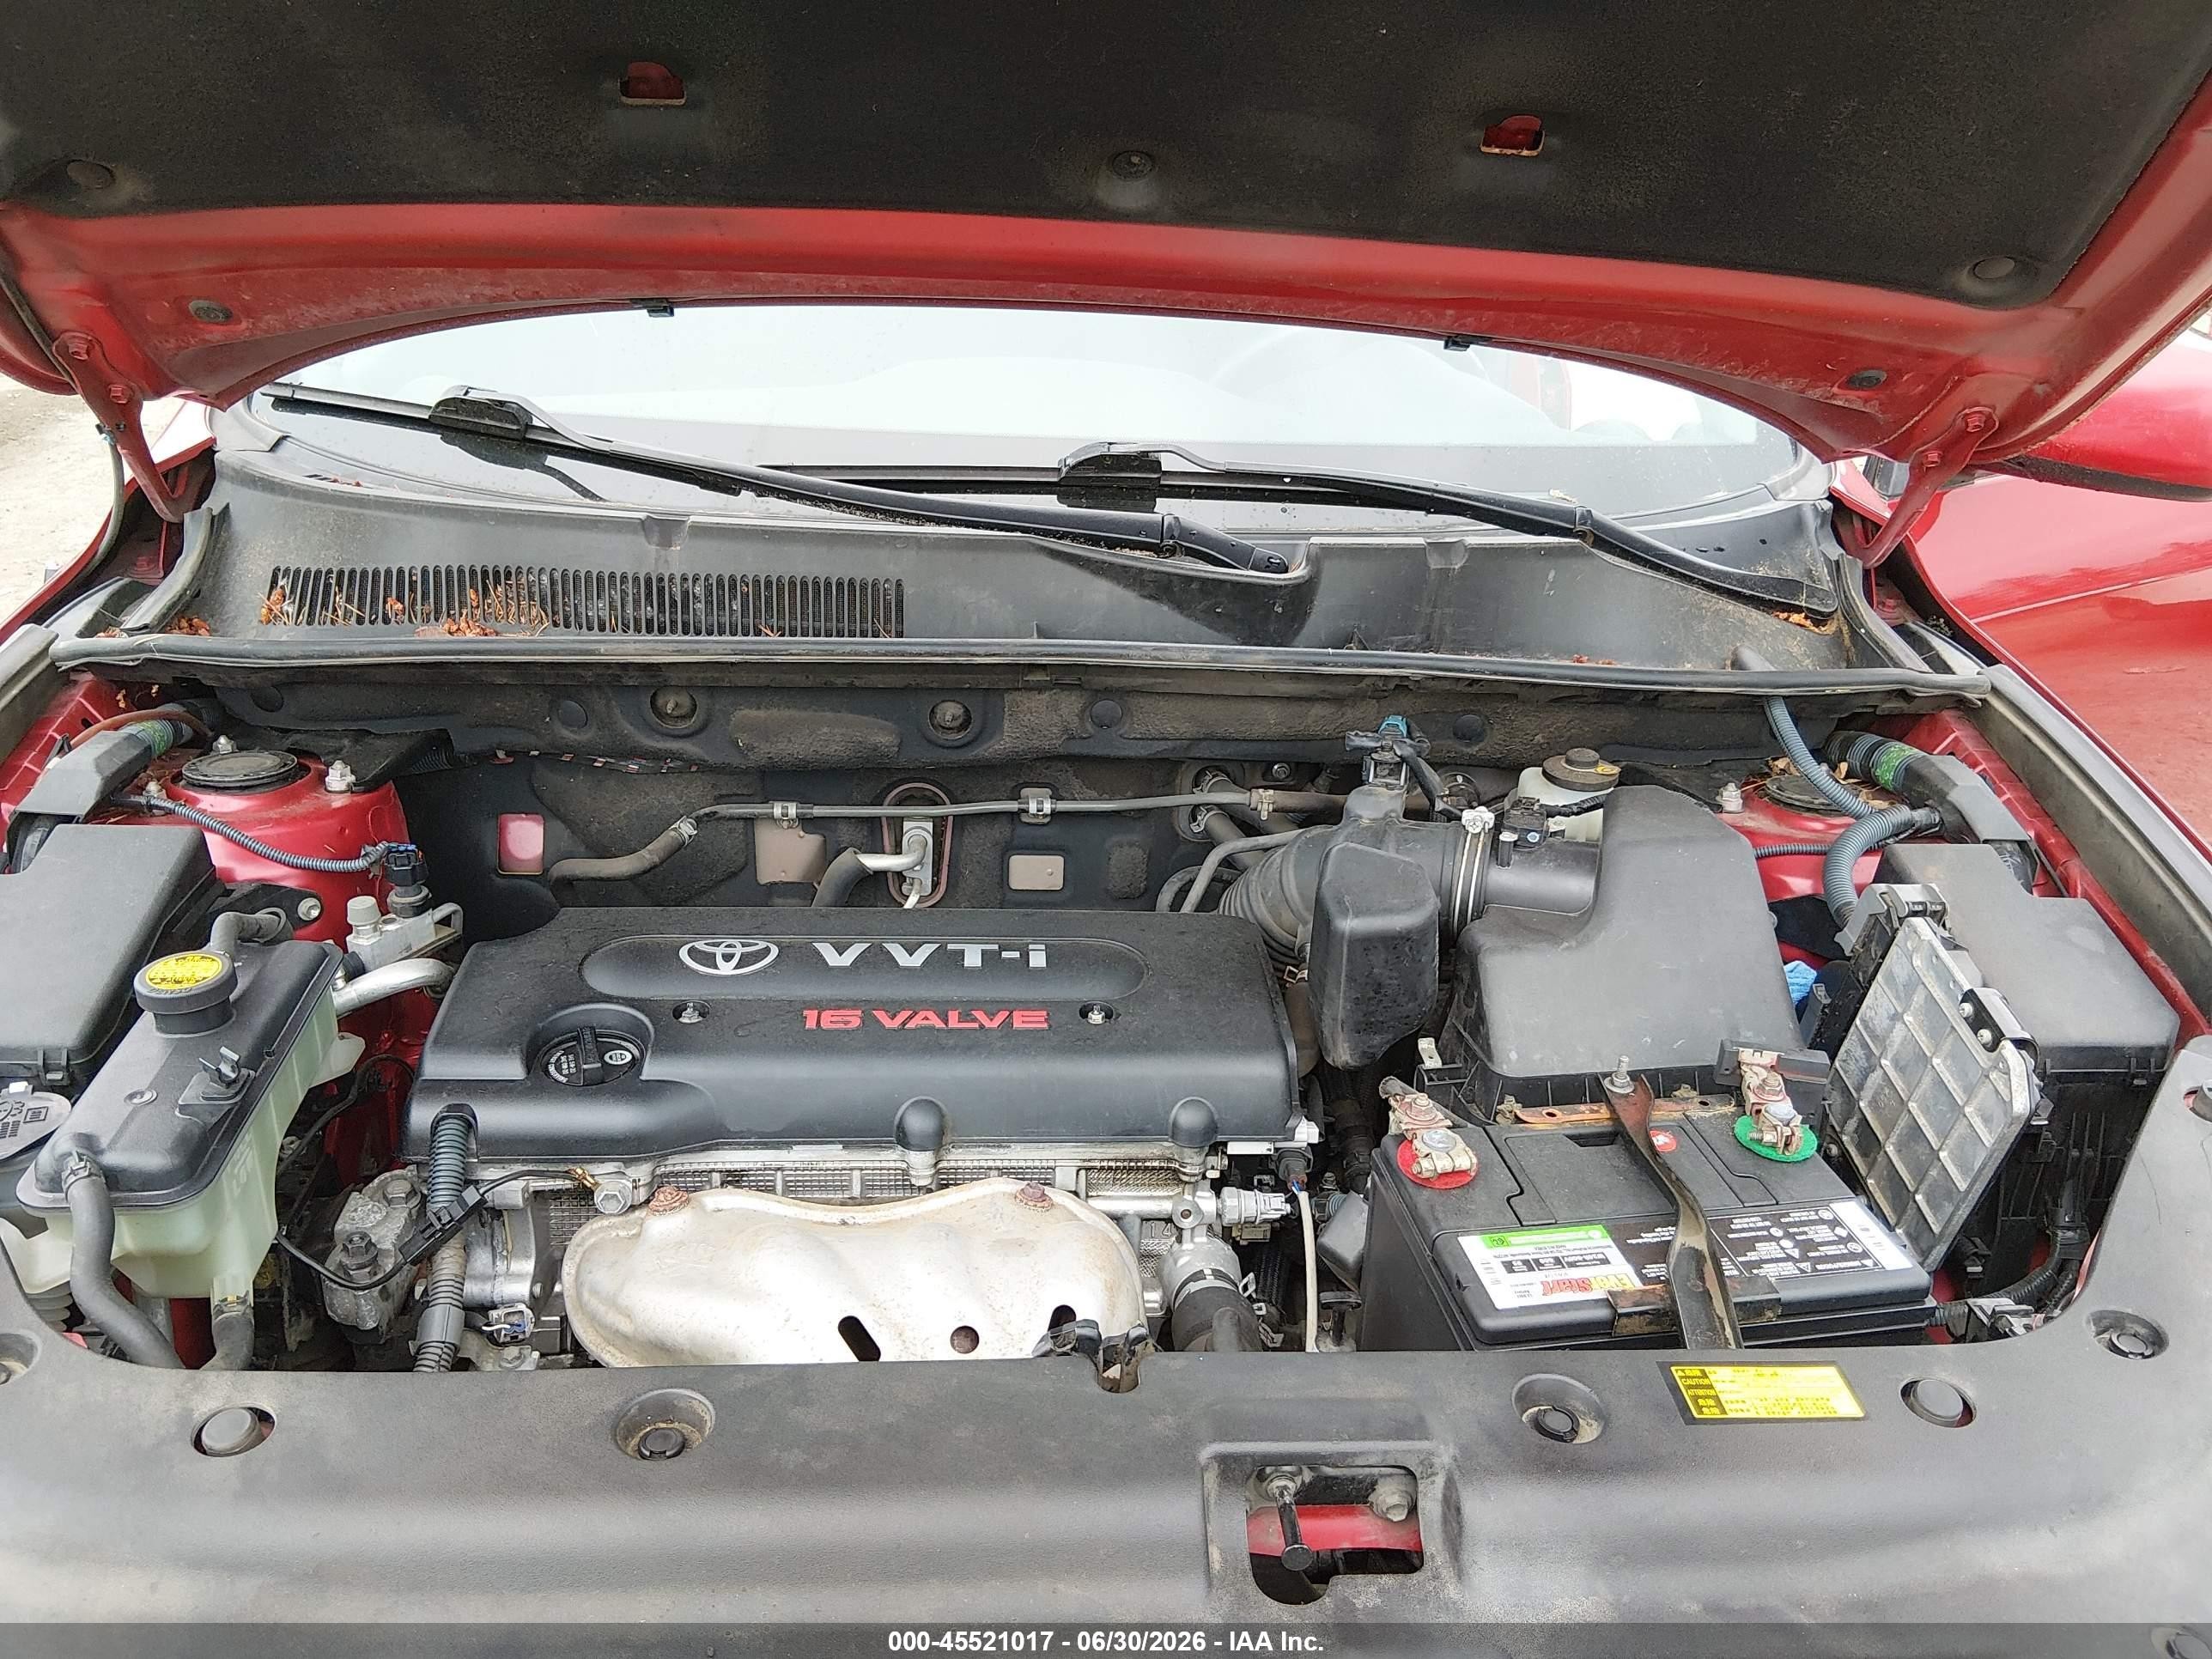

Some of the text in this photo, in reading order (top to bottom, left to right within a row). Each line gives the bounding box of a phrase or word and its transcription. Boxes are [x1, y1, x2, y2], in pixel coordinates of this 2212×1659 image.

[812, 942, 1047, 969] VVT-i
[803, 1009, 1049, 1030] 16 VALVE
